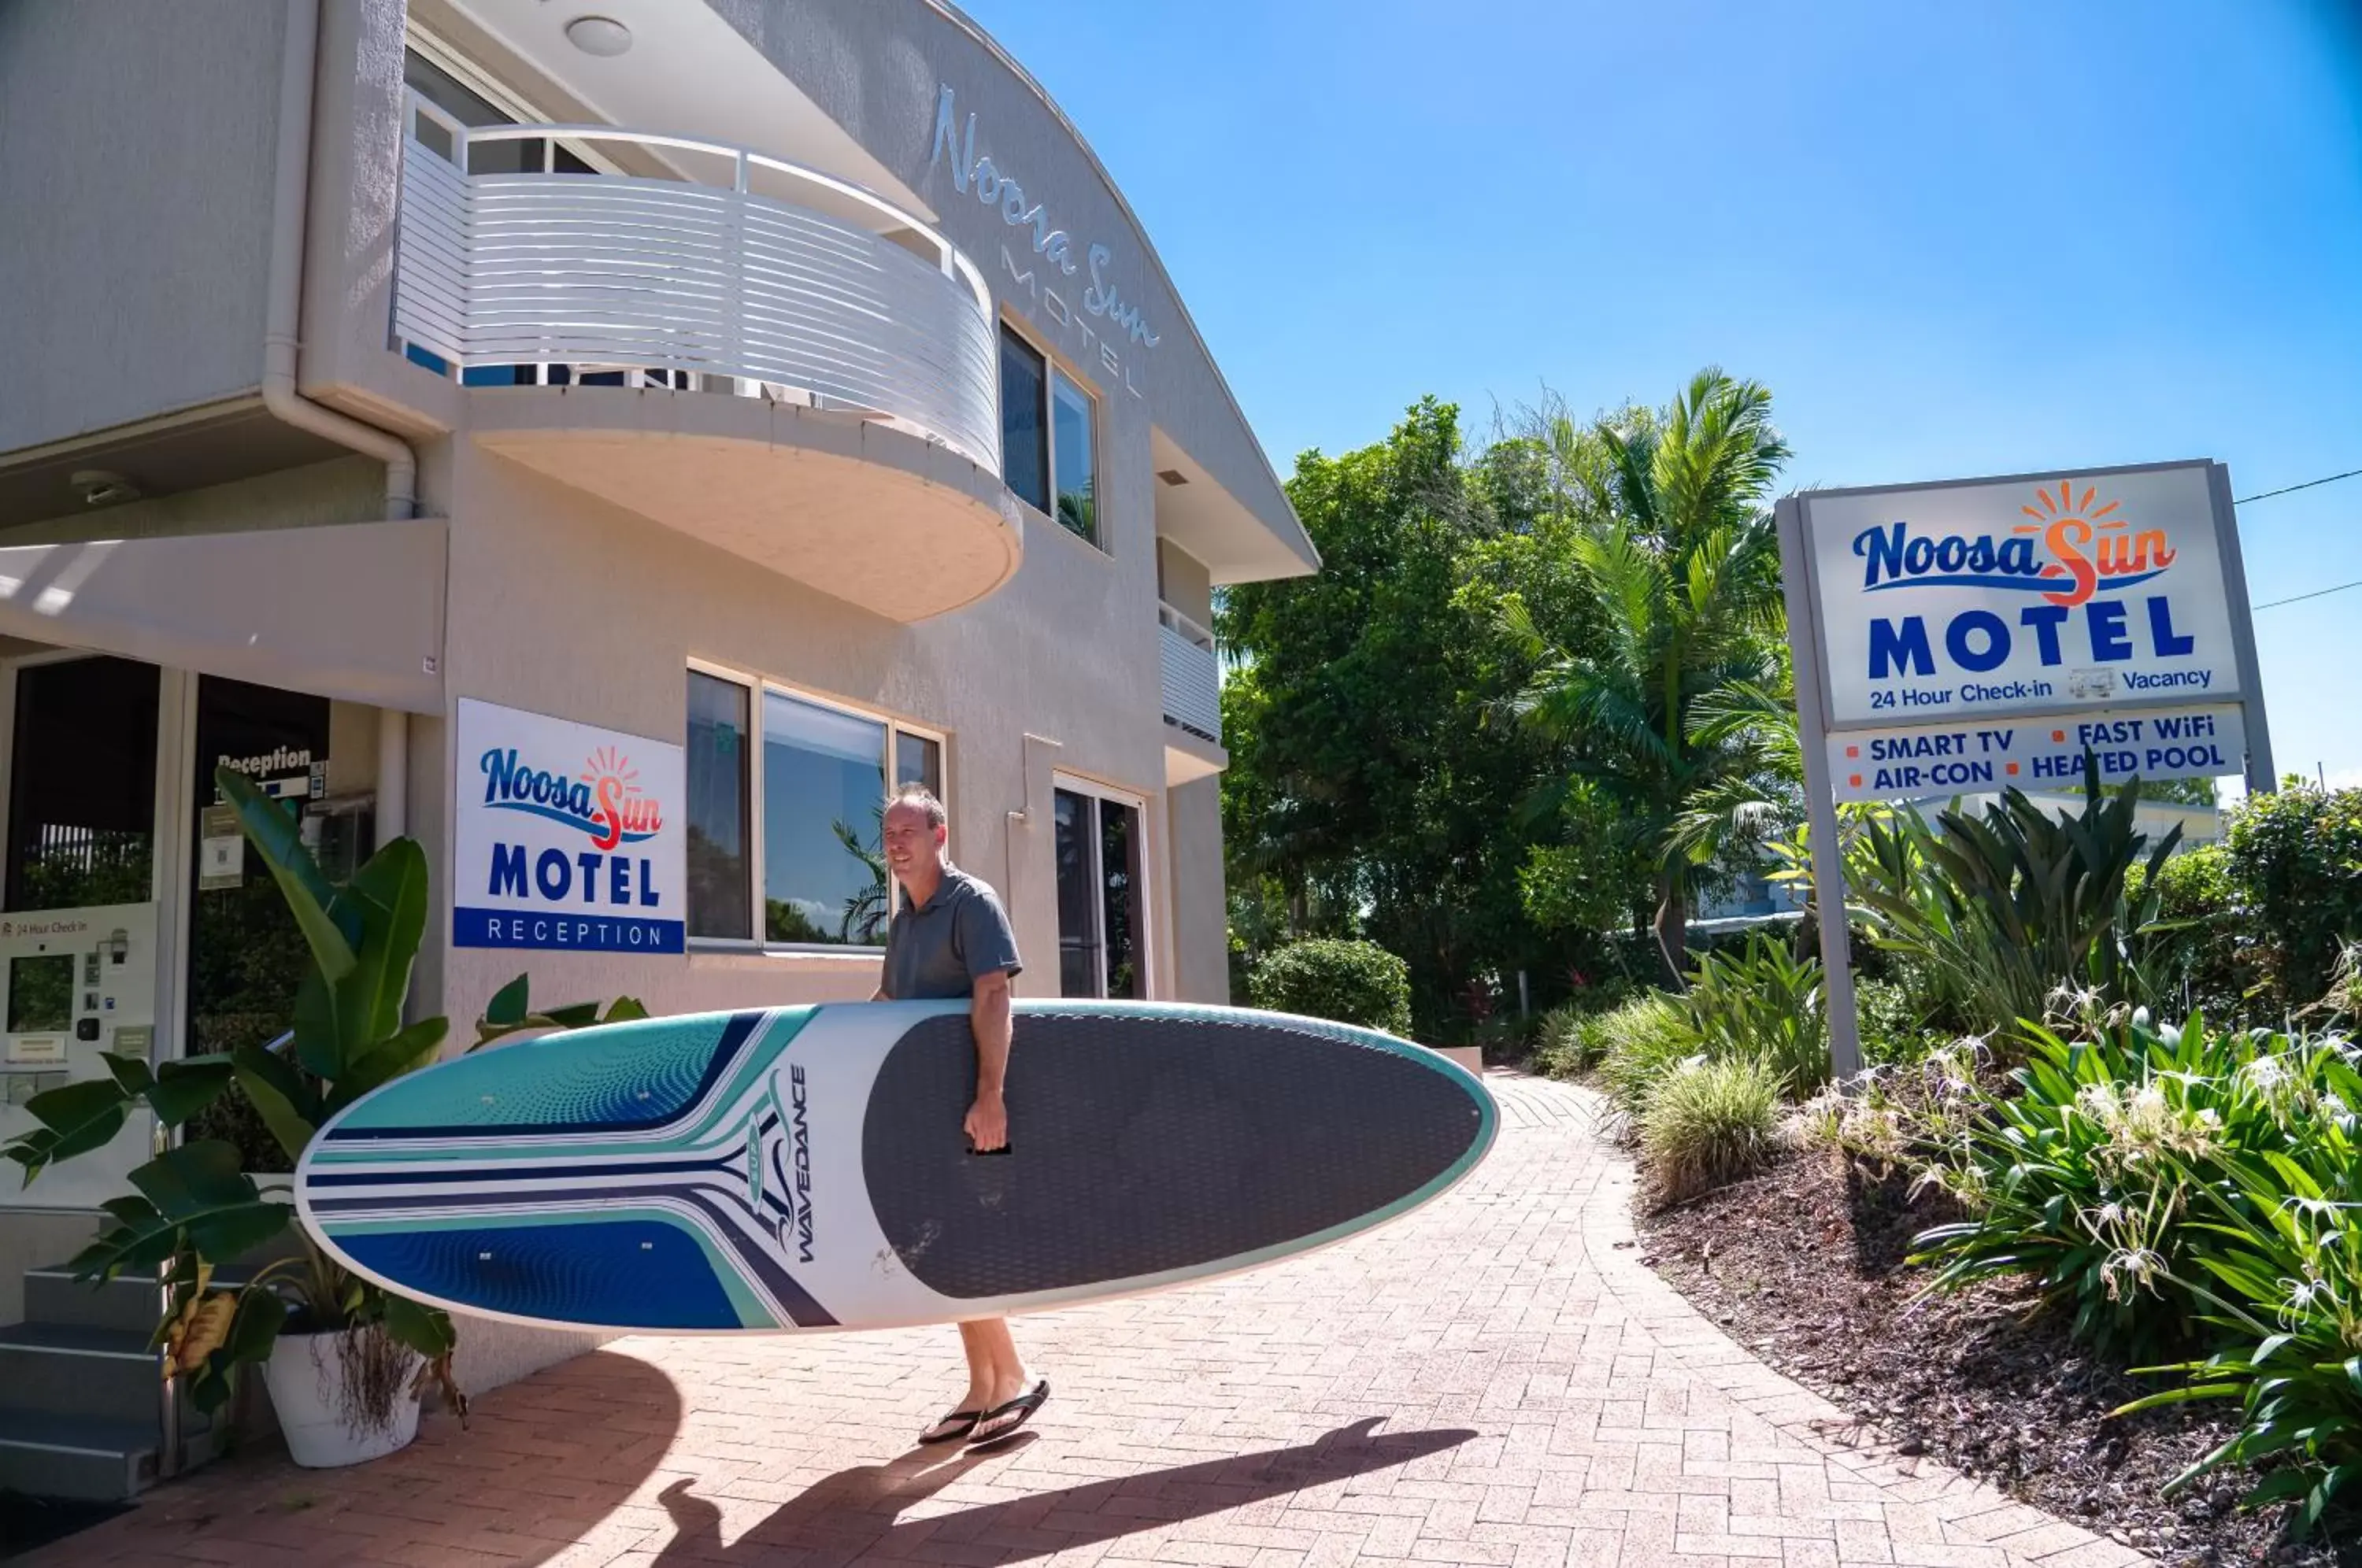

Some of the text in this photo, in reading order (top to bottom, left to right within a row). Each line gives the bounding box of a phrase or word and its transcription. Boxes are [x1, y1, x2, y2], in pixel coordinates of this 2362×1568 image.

[931, 83, 1161, 348] Noosa Sun
[1001, 244, 1145, 400] MOTEL
[1853, 519, 2175, 607] Noosa Sun
[1868, 596, 2194, 679] MOTEL
[1870, 670, 2212, 709] 24 Hour Check-in Vacancy
[1870, 730, 2013, 761] SMART TV
[2078, 715, 2215, 745] FAST WiFi
[1874, 760, 1993, 790] AIR-CON
[2145, 745, 2225, 771] POOL
[480, 749, 663, 851] Noosa Sun
[488, 843, 661, 907] MOTEL
[51, 919, 76, 933] Check
[489, 919, 661, 945] RECEPTION
[790, 1063, 814, 1263] WAVEDANCE
